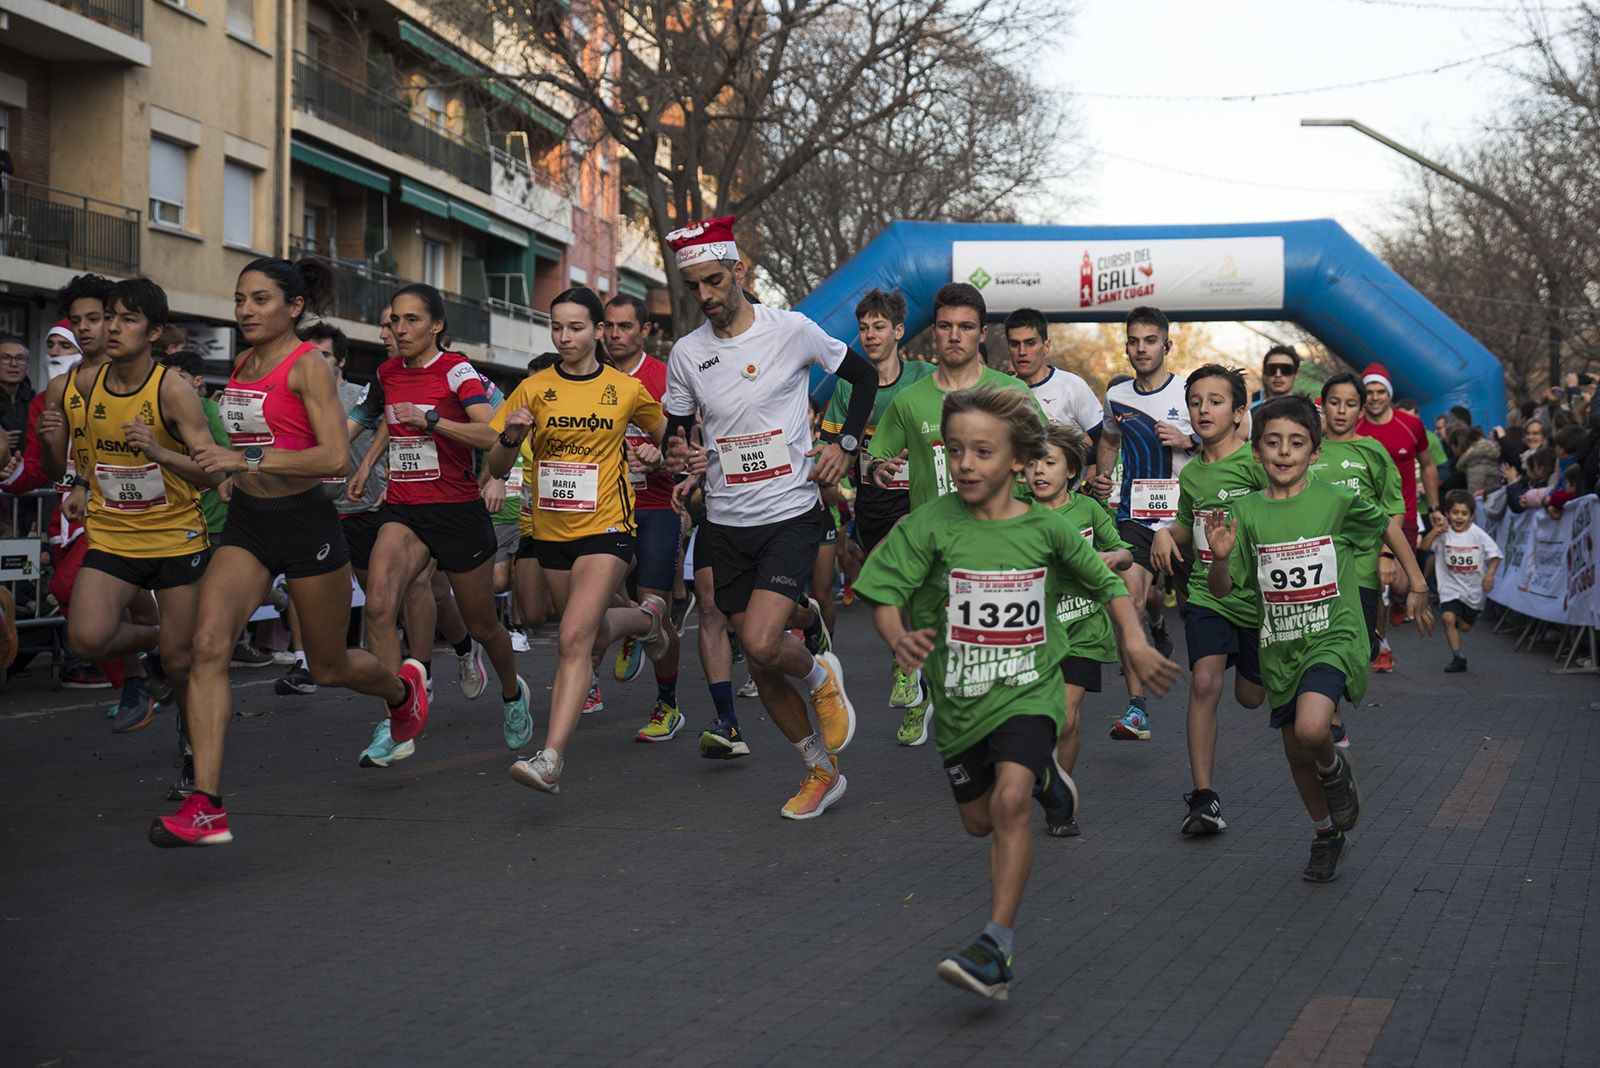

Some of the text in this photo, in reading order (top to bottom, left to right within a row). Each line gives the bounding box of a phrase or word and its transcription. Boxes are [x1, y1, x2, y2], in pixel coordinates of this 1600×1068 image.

[1098, 248, 1151, 270] CURSA DEL
[1098, 267, 1139, 292] GALL
[1097, 284, 1154, 304] SANT CUGAT
[698, 355, 720, 373] HOKA
[227, 411, 244, 421] ELISA
[233, 422, 242, 431] 2
[96, 439, 143, 455] ASMO
[399, 453, 421, 461] ESTELA
[741, 451, 764, 462] NANO
[402, 461, 419, 470] 571
[742, 460, 767, 472] 623
[552, 479, 576, 489] MARIA
[119, 491, 142, 500] 839
[552, 489, 574, 499] 665
[1148, 501, 1168, 510] 666
[1450, 555, 1473, 566] 936
[771, 575, 797, 587] HOKA
[1270, 563, 1323, 589] 937
[958, 600, 1040, 628] 1320
[964, 661, 998, 685] SANT
